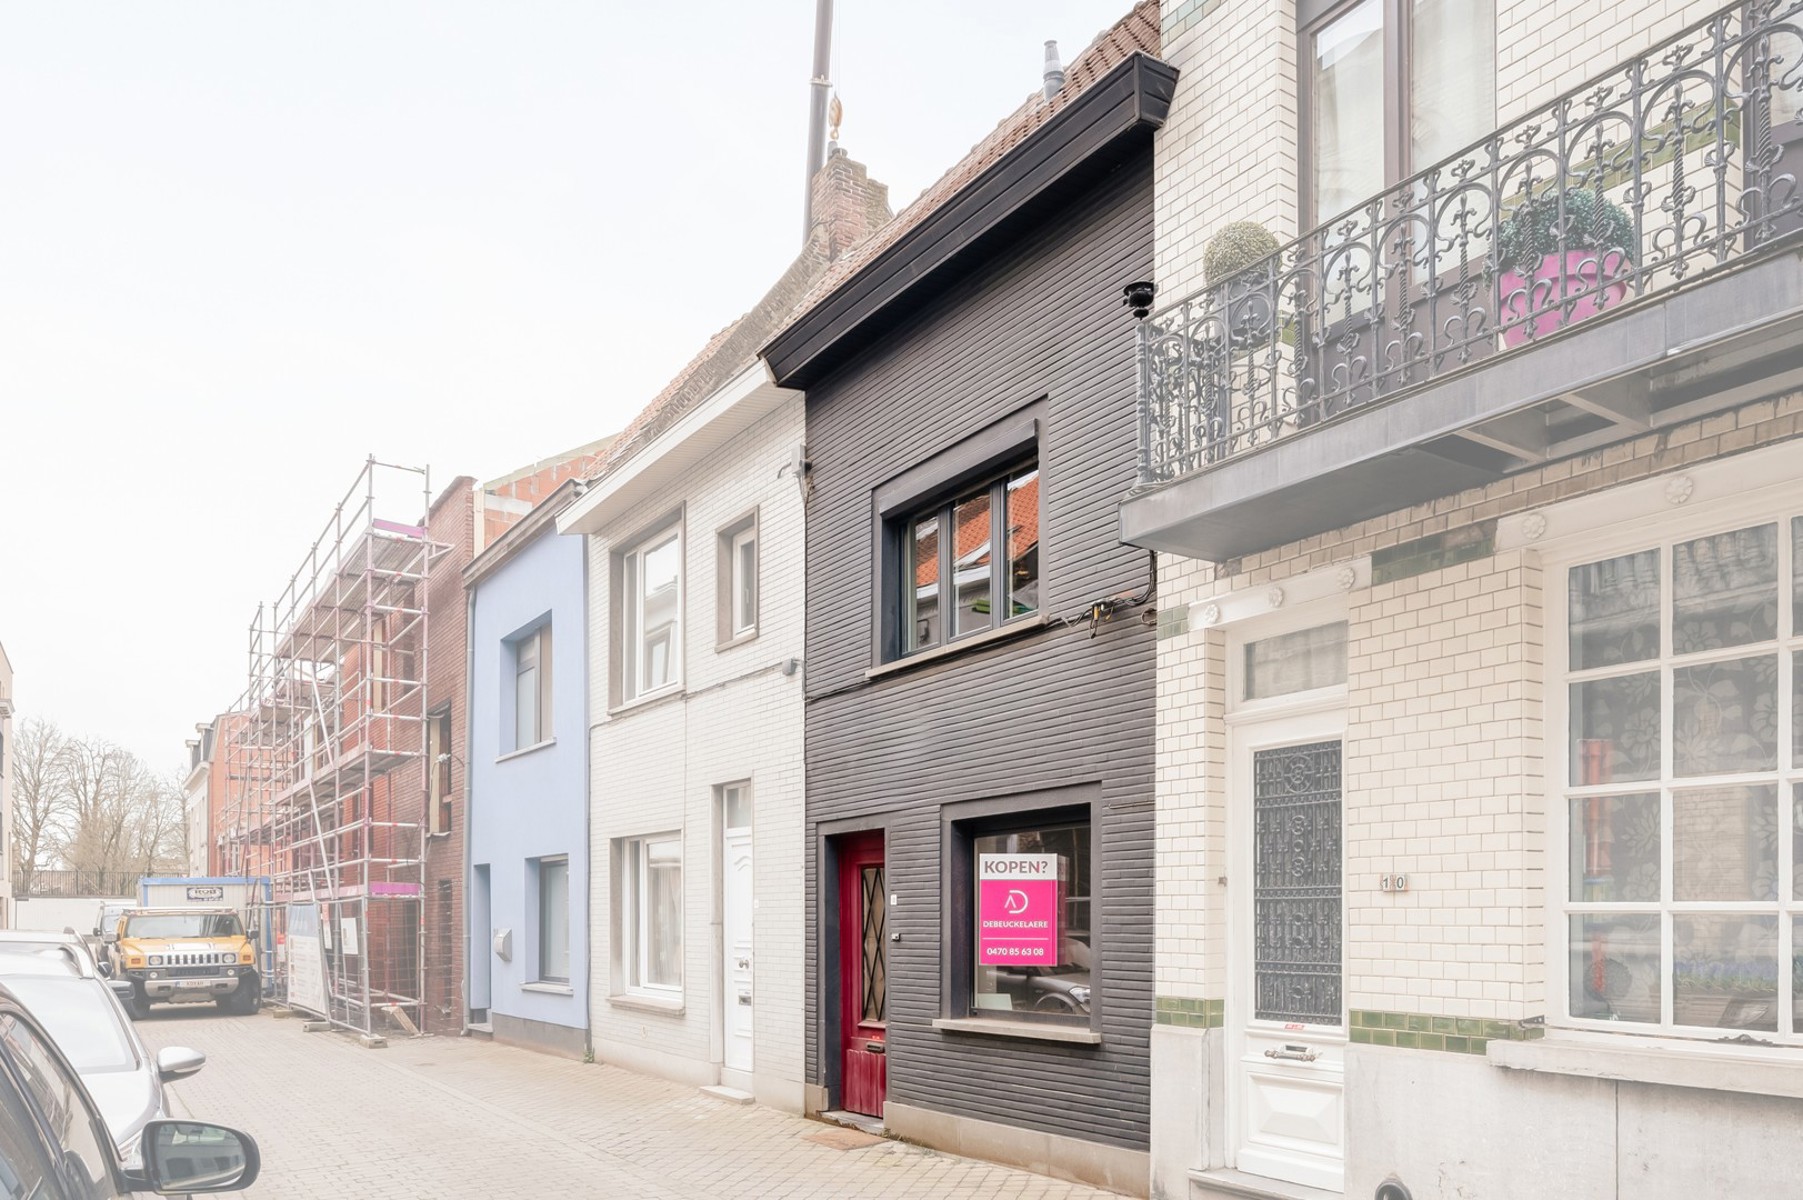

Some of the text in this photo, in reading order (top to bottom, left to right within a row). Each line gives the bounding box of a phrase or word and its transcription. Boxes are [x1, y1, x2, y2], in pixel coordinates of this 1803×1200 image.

[984, 861, 1048, 873] KOPEN?
[1383, 876, 1404, 889] 10
[986, 947, 1044, 956] 0470 85 63 08
